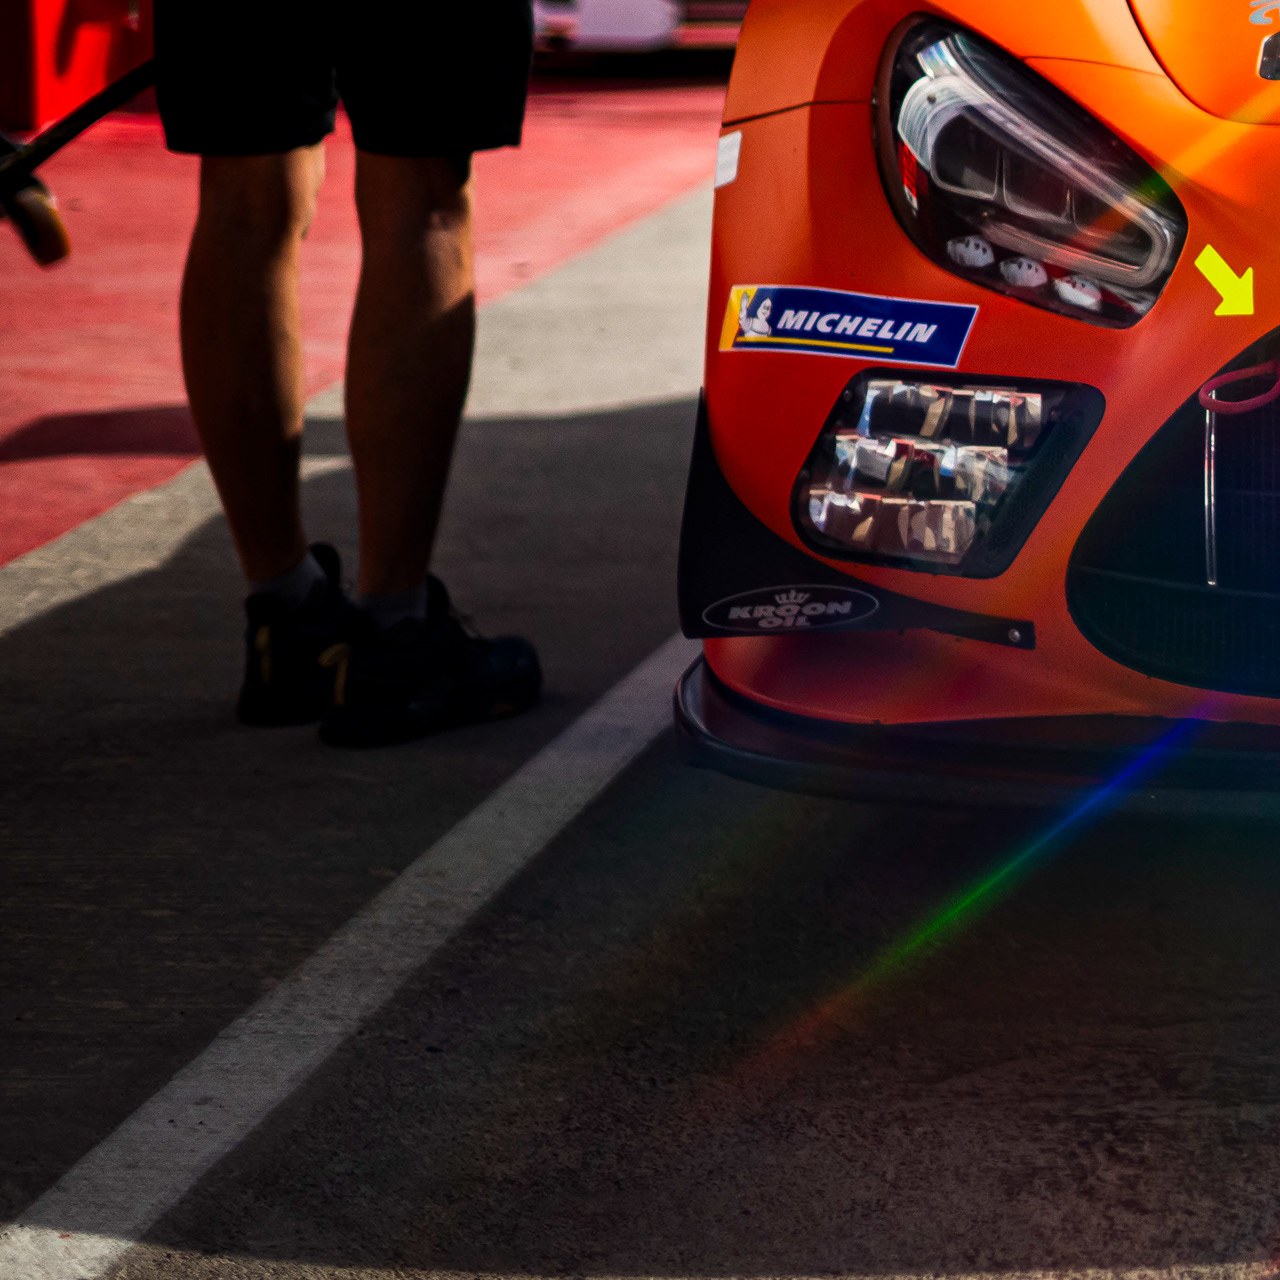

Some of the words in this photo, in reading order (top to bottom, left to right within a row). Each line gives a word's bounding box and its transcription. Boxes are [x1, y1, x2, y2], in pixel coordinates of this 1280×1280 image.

[776, 309, 938, 343] MICHELIN
[728, 600, 852, 620] KROON
[757, 614, 812, 629] OIL
